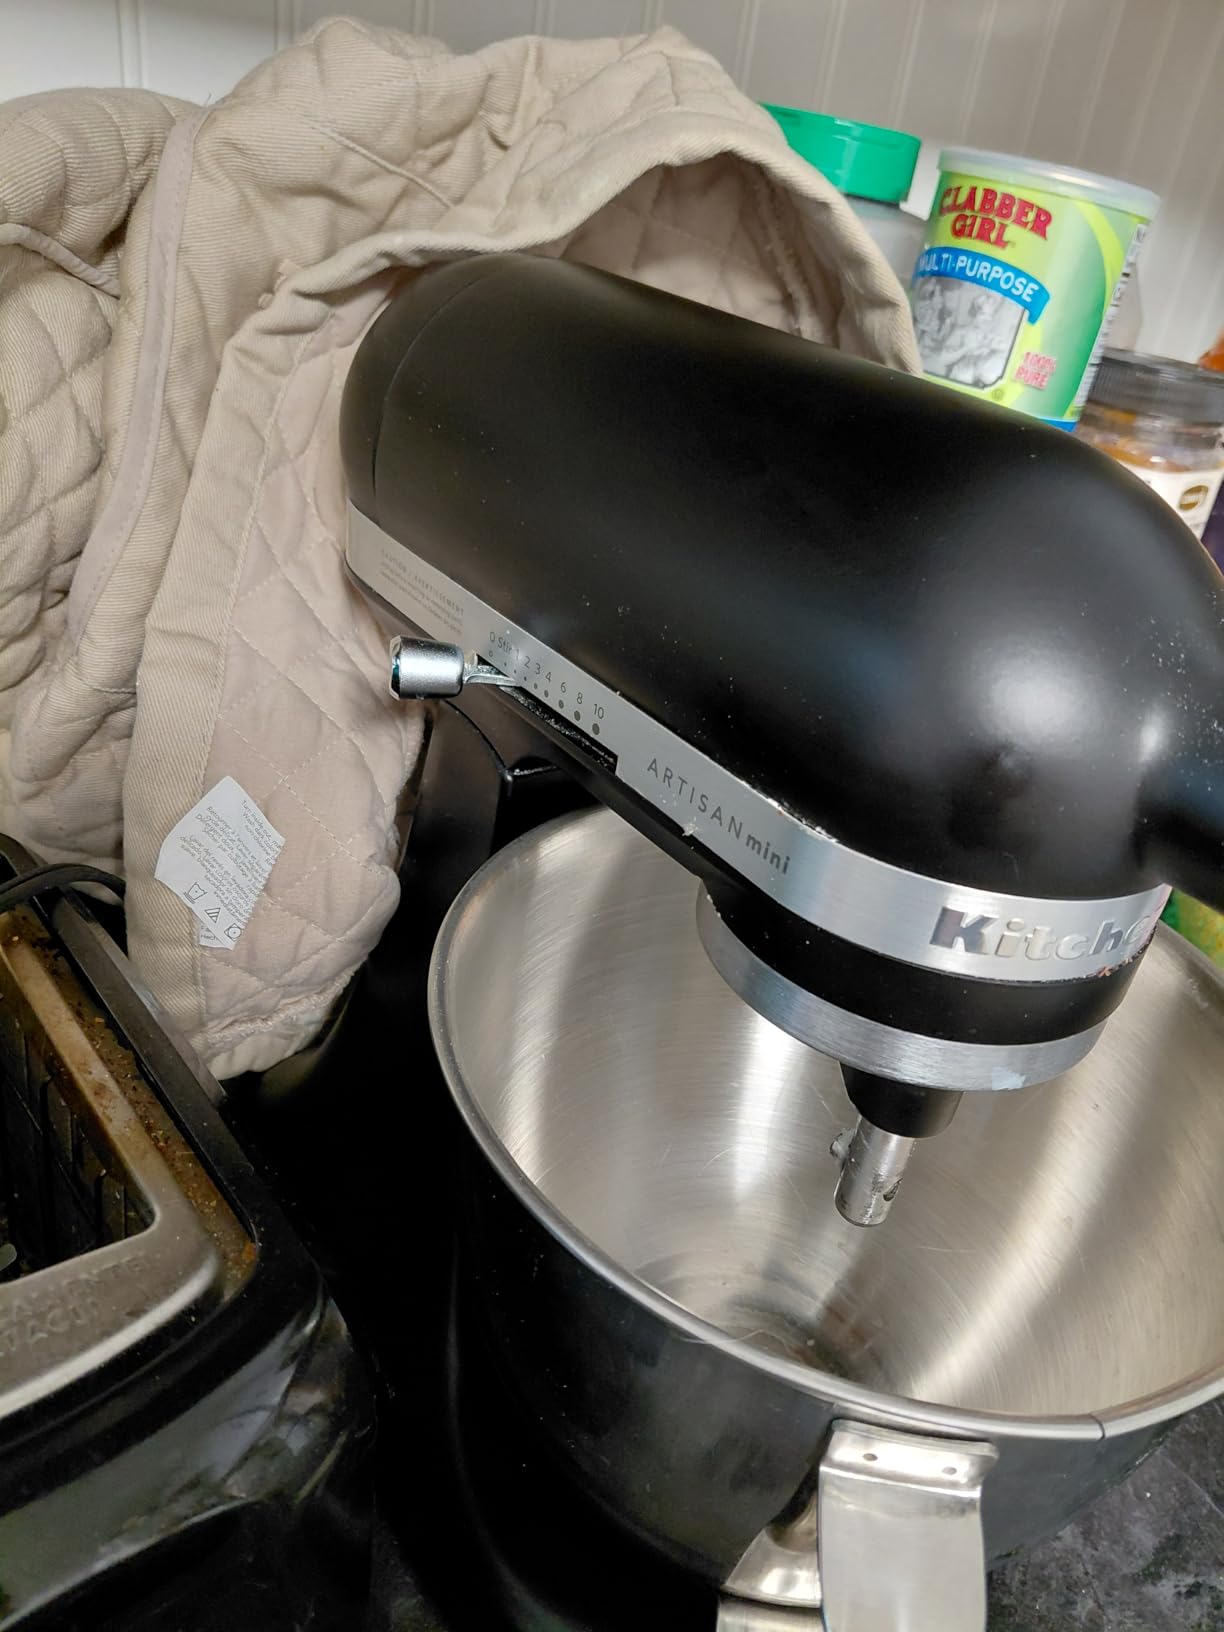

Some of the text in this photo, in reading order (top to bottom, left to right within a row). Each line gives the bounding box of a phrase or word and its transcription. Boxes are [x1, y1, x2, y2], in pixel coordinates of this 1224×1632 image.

[939, 186, 1053, 240] CLABBER
[951, 213, 1010, 249] GIRL
[1014, 367, 1047, 390] PURE
[524, 656, 532, 669] 2
[534, 663, 541, 675] 3
[545, 671, 552, 683] 4
[560, 681, 567, 694] 6
[576, 691, 584, 704] 8
[593, 703, 606, 720] 10
[647, 758, 791, 875] ARTISAN mini
